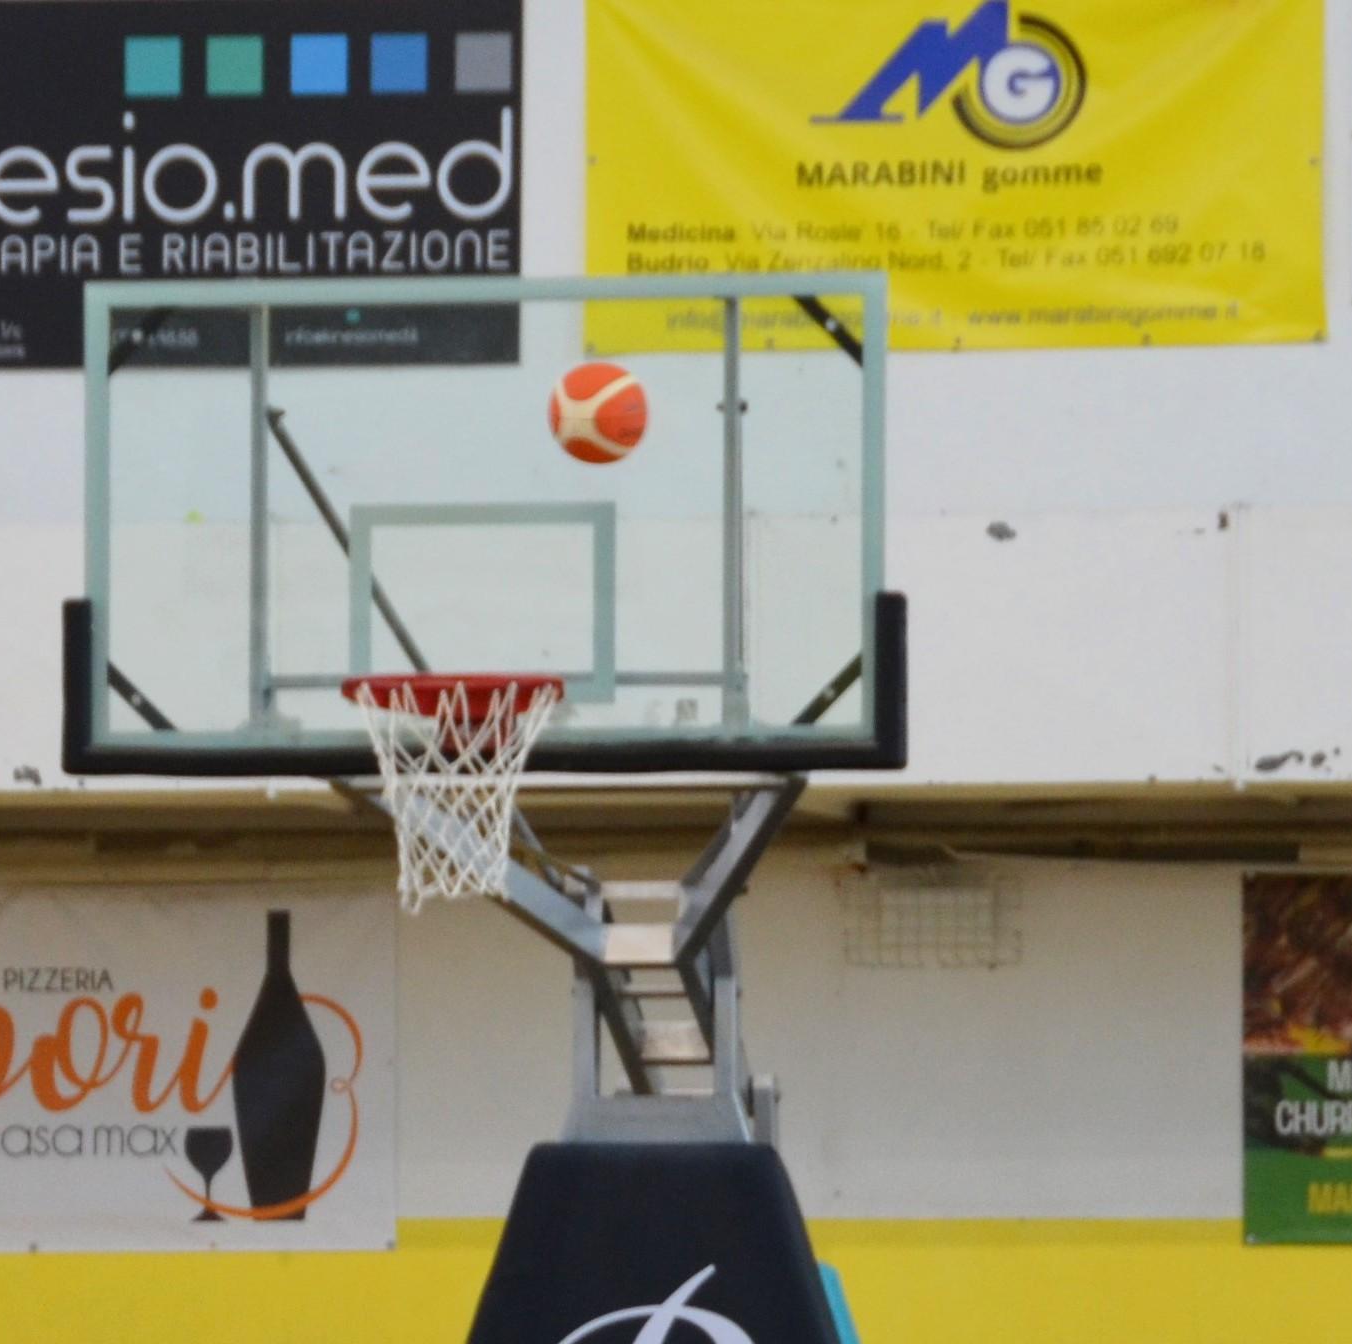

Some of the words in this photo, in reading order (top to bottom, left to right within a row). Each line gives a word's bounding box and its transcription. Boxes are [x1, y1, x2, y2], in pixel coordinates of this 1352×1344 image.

[796, 160, 966, 188] MARABINI
[983, 161, 1103, 192] gomme
[626, 221, 736, 243] Medicina
[750, 221, 787, 242] Via
[973, 218, 1014, 240] Fax
[1024, 216, 1066, 237] 051
[118, 233, 143, 275] E
[161, 229, 511, 272] RIABILITAZIONE
[626, 252, 709, 274] Budrio
[725, 252, 758, 273] Via
[1045, 247, 1086, 268] Fax
[1095, 245, 1138, 266] 051
[3, 966, 114, 993] PIZZERIA
[93, 1123, 178, 1158] max
